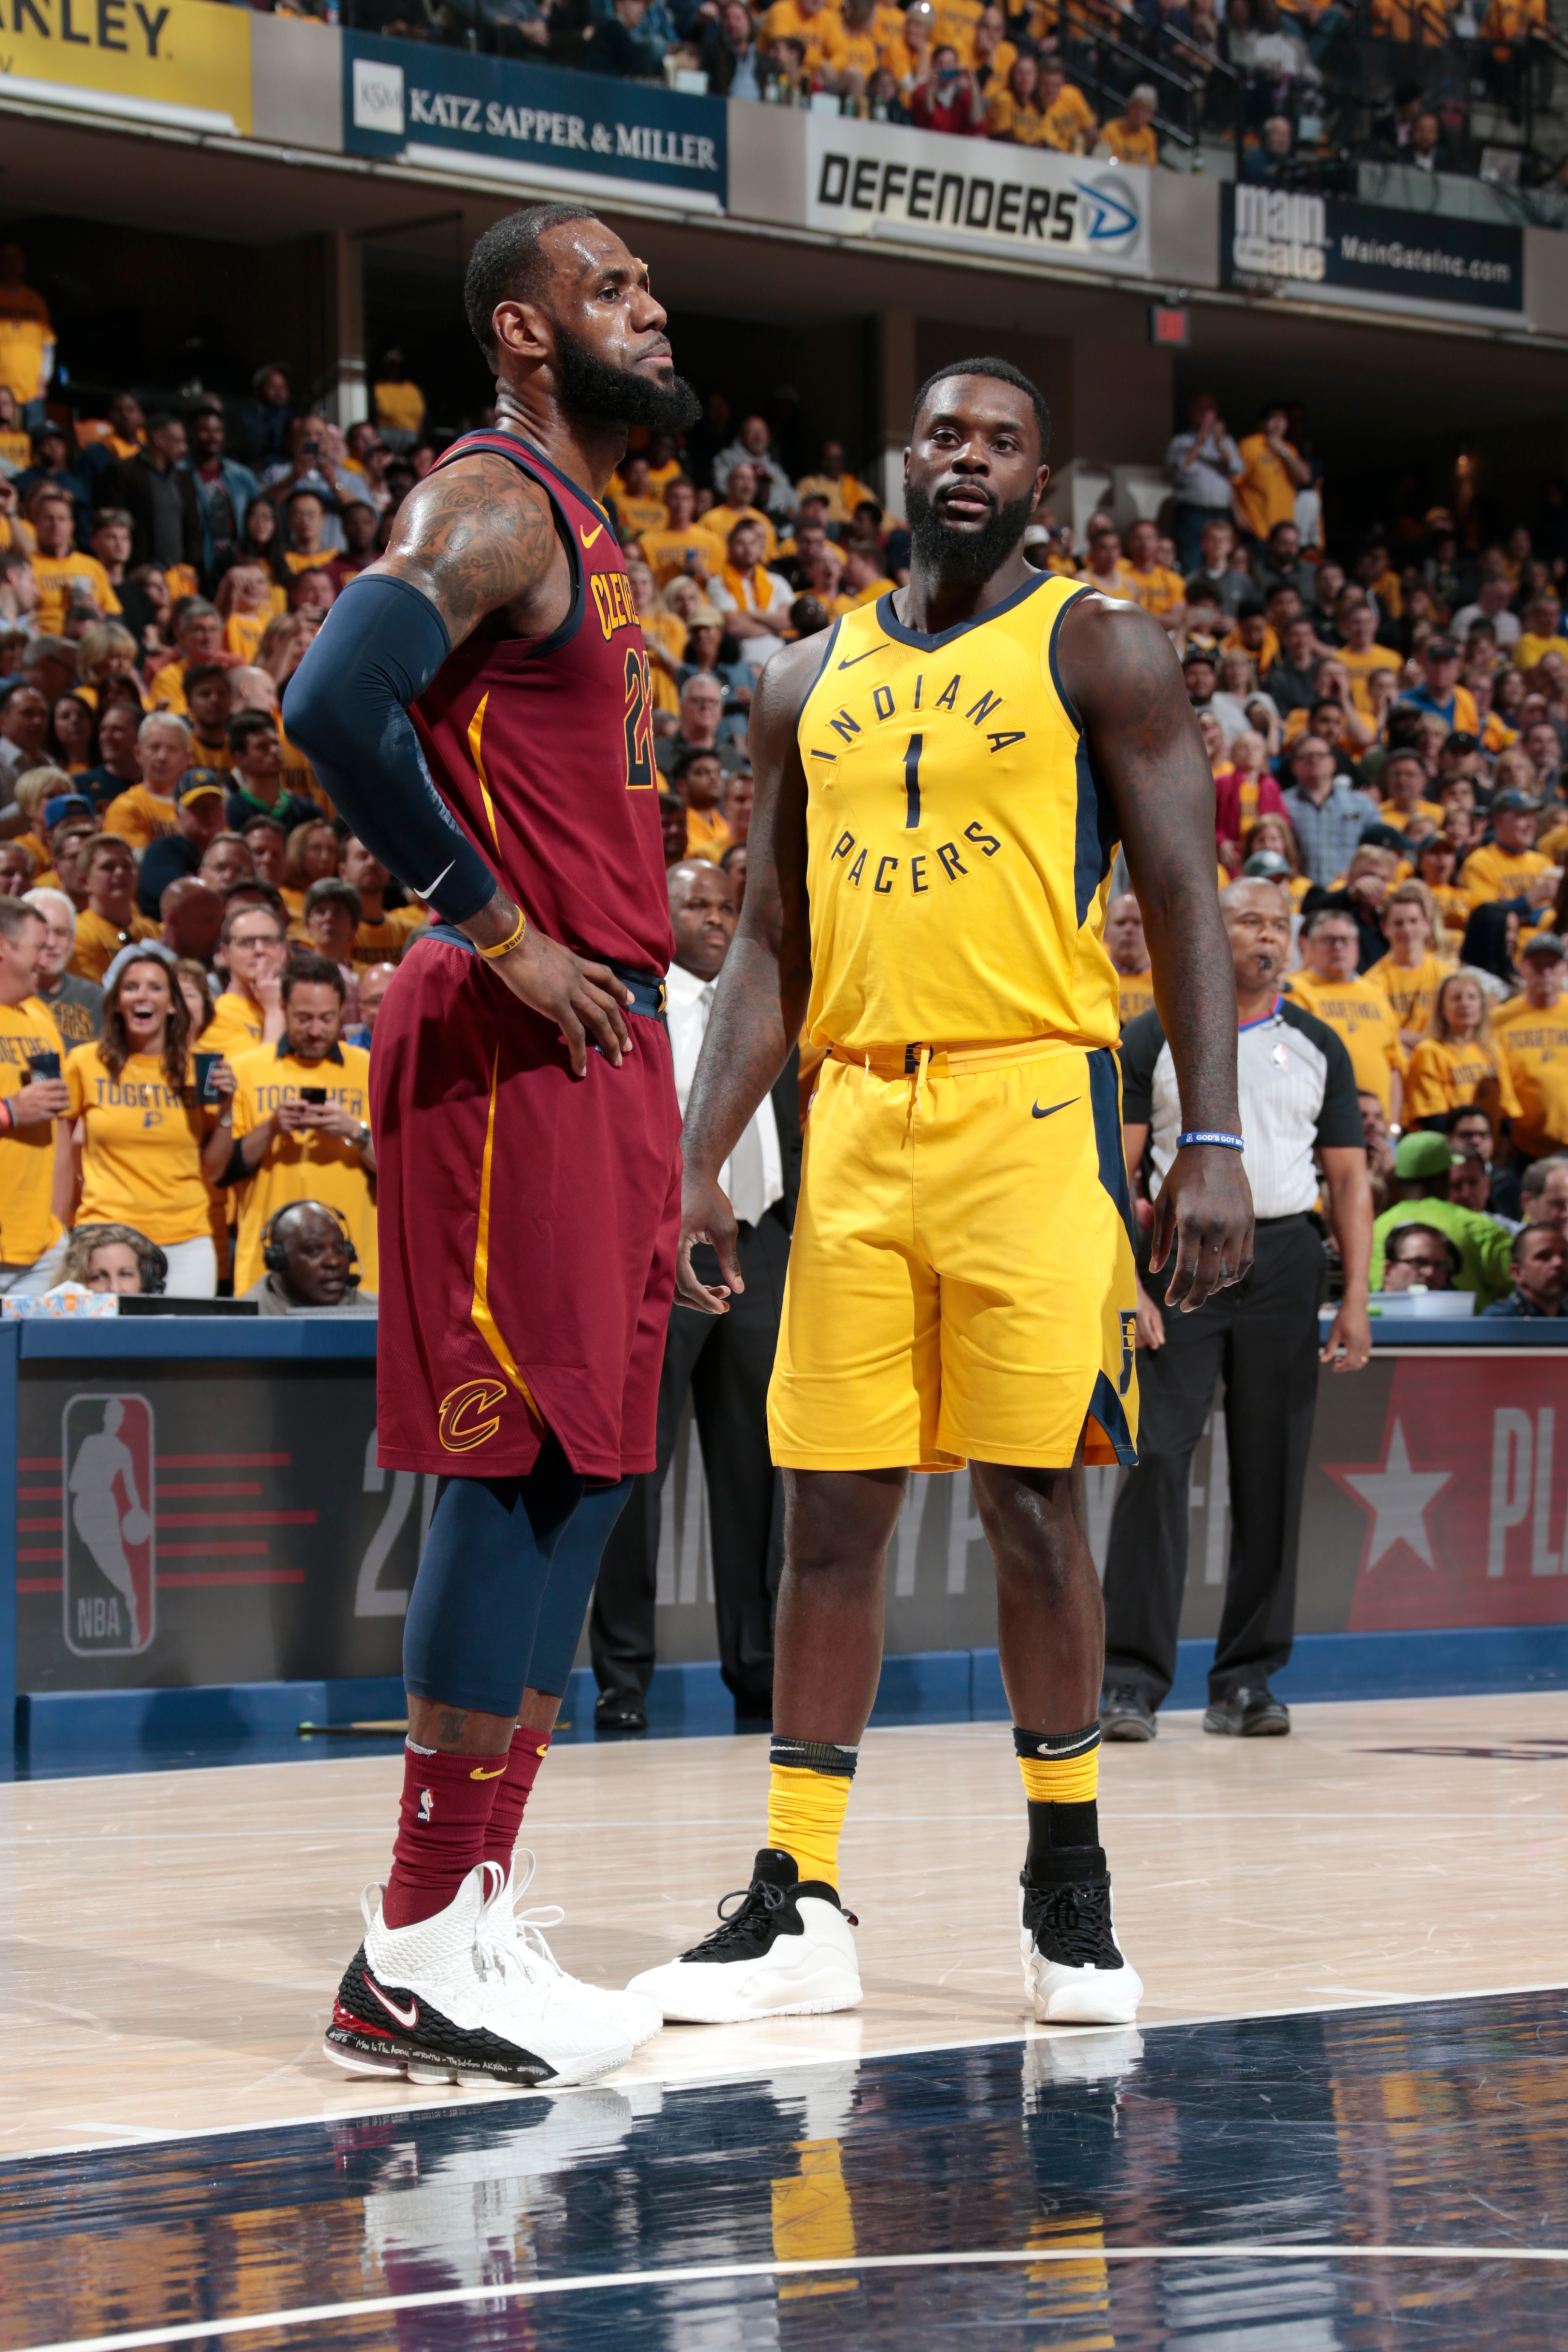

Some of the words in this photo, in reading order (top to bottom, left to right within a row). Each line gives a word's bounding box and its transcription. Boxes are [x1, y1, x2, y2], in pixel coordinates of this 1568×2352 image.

[409, 87, 482, 133] KATZ
[486, 101, 588, 151] SAPPER
[591, 121, 613, 154] &
[615, 123, 719, 171] MILLER
[818, 152, 1078, 242] DEFENDERS
[1341, 233, 1511, 283] MainGateInc.com
[810, 674, 1027, 762] INDIANA
[902, 733, 923, 829] 1
[831, 821, 1002, 894] PACERS
[78, 1597, 120, 1637] NBA
